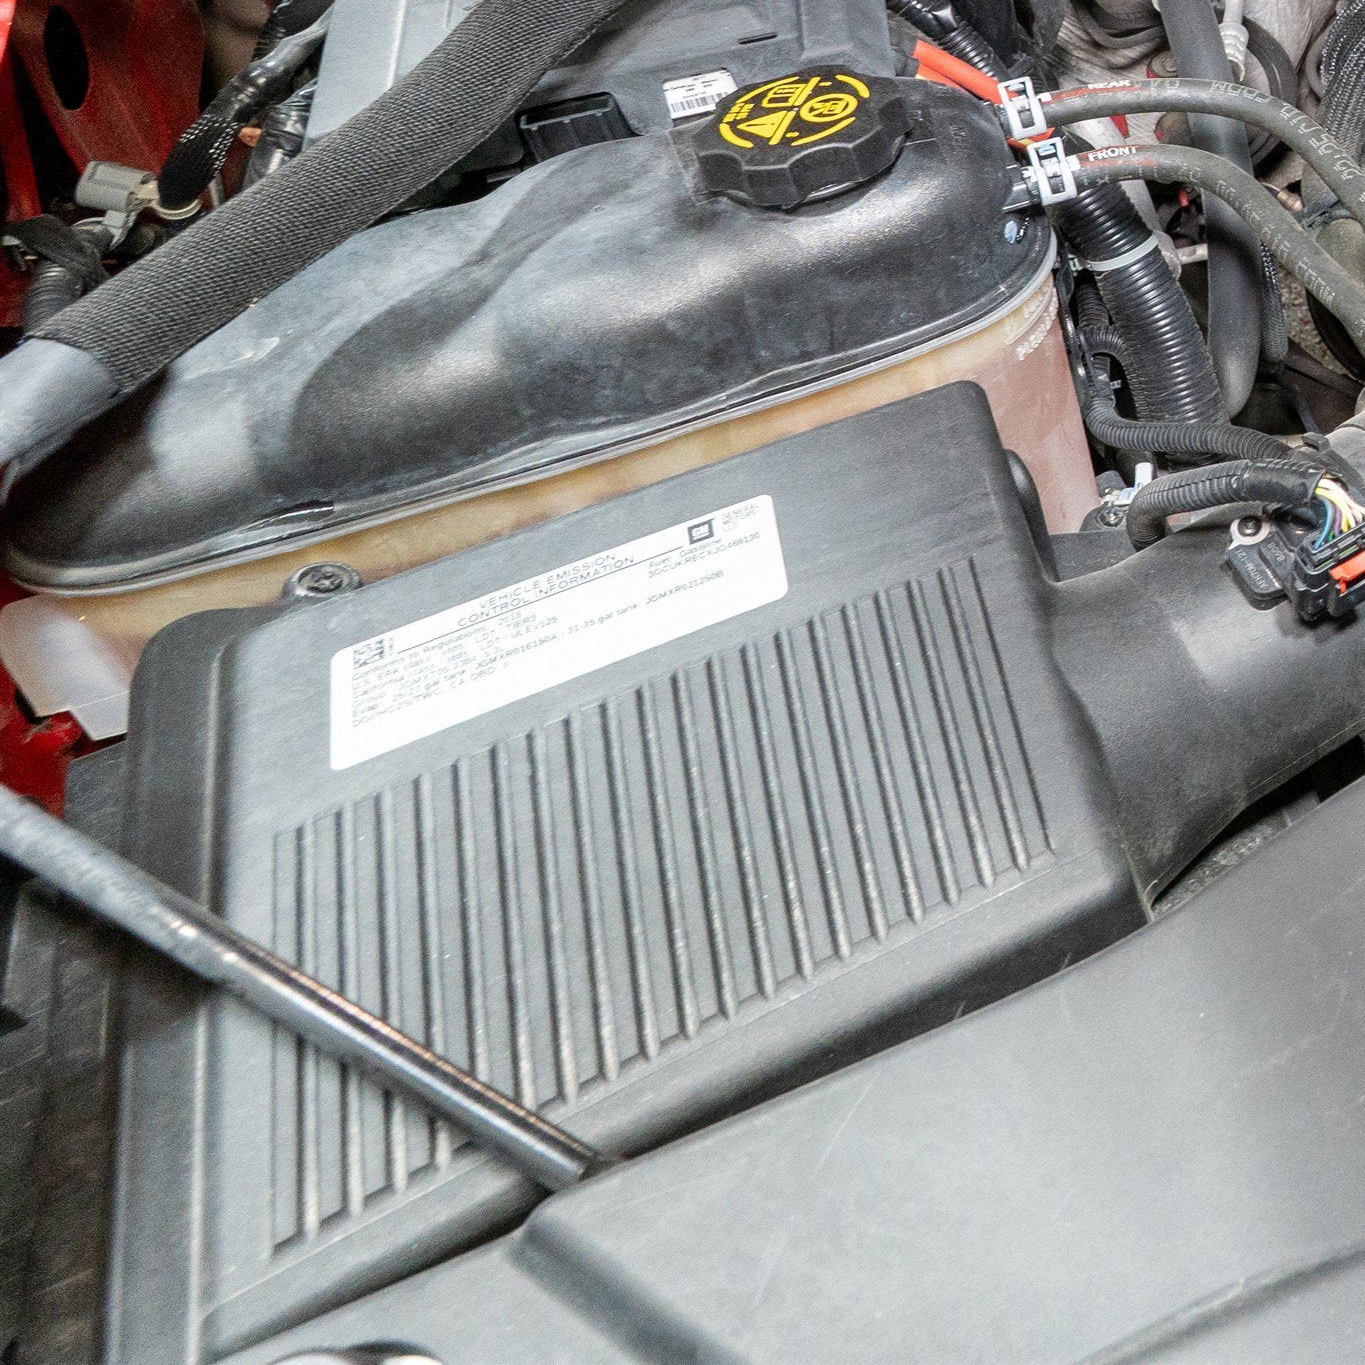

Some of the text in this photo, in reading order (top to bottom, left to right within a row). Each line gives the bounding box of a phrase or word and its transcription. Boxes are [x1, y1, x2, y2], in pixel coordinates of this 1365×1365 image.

[1087, 145, 1139, 162] FRONT
[457, 556, 633, 626] CONTROL INFORMATION
[479, 554, 615, 608] VEHICLE EMISSION
